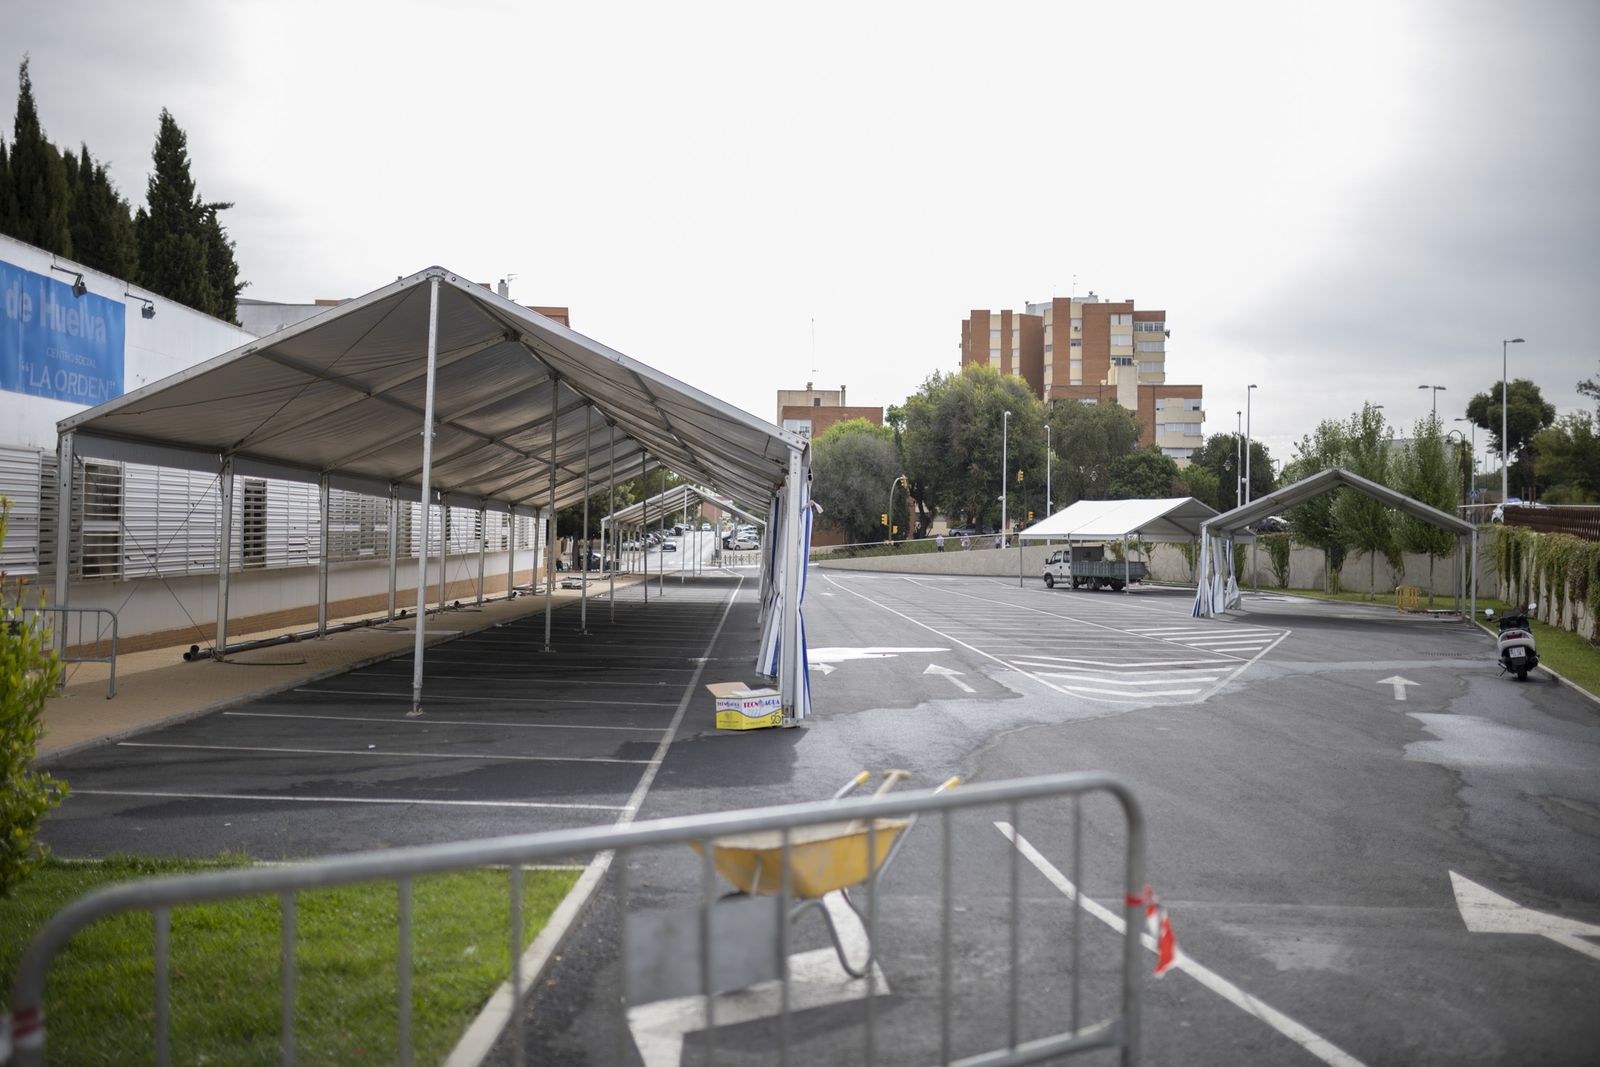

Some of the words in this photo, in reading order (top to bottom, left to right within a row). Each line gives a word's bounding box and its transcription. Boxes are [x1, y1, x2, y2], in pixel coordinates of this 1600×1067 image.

[6, 281, 32, 322] de
[40, 281, 106, 344] Huelva
[46, 347, 75, 363] CENTRO
[74, 355, 96, 368] SOCIAL
